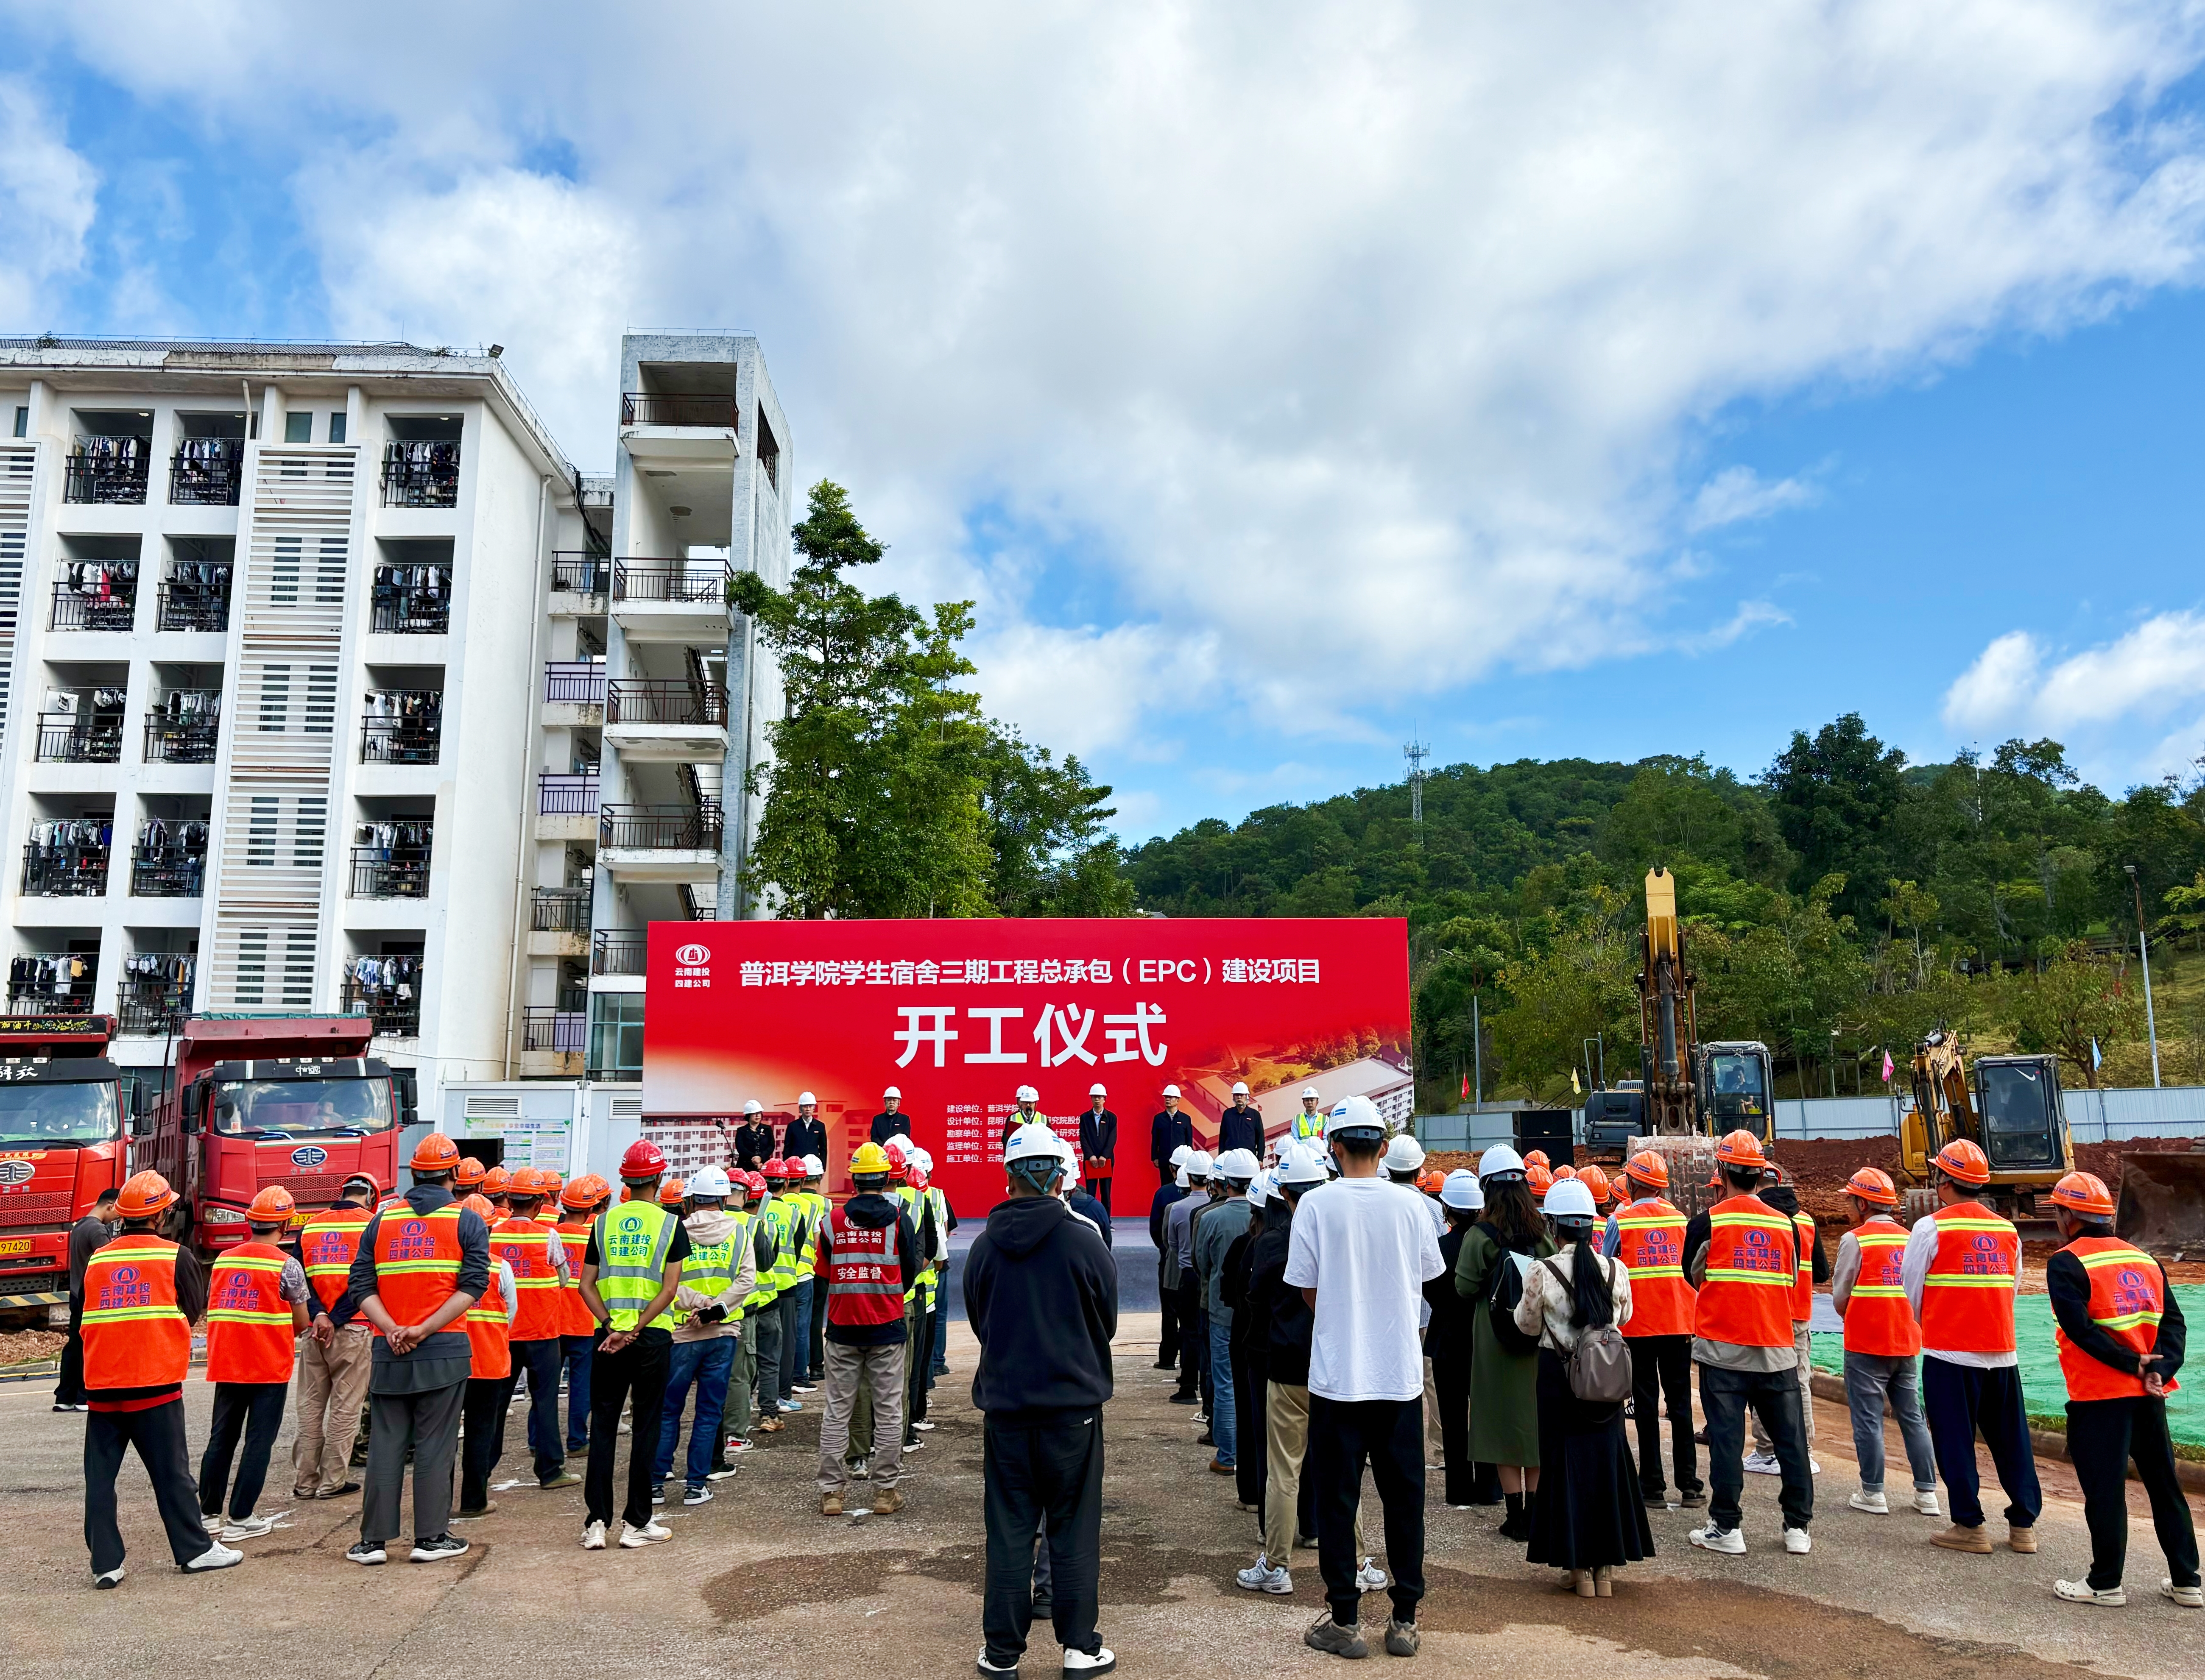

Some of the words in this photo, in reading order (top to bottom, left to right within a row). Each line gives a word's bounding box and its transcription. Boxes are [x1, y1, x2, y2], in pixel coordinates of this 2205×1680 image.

[675, 967, 710, 976] 云南建投
[675, 979, 710, 988] 四建公司
[894, 1002, 1167, 1068] 开工仪式
[608, 1234, 652, 1245] 云南建投
[1, 1241, 30, 1252] 97420
[610, 1246, 648, 1257] 四建公司
[1733, 1246, 1781, 1260] 云南建投
[1733, 1258, 1780, 1271] 四建公司
[837, 1266, 882, 1280] 安全监督
[100, 1282, 150, 1297] 云南建投
[100, 1294, 150, 1310] 四建公司
